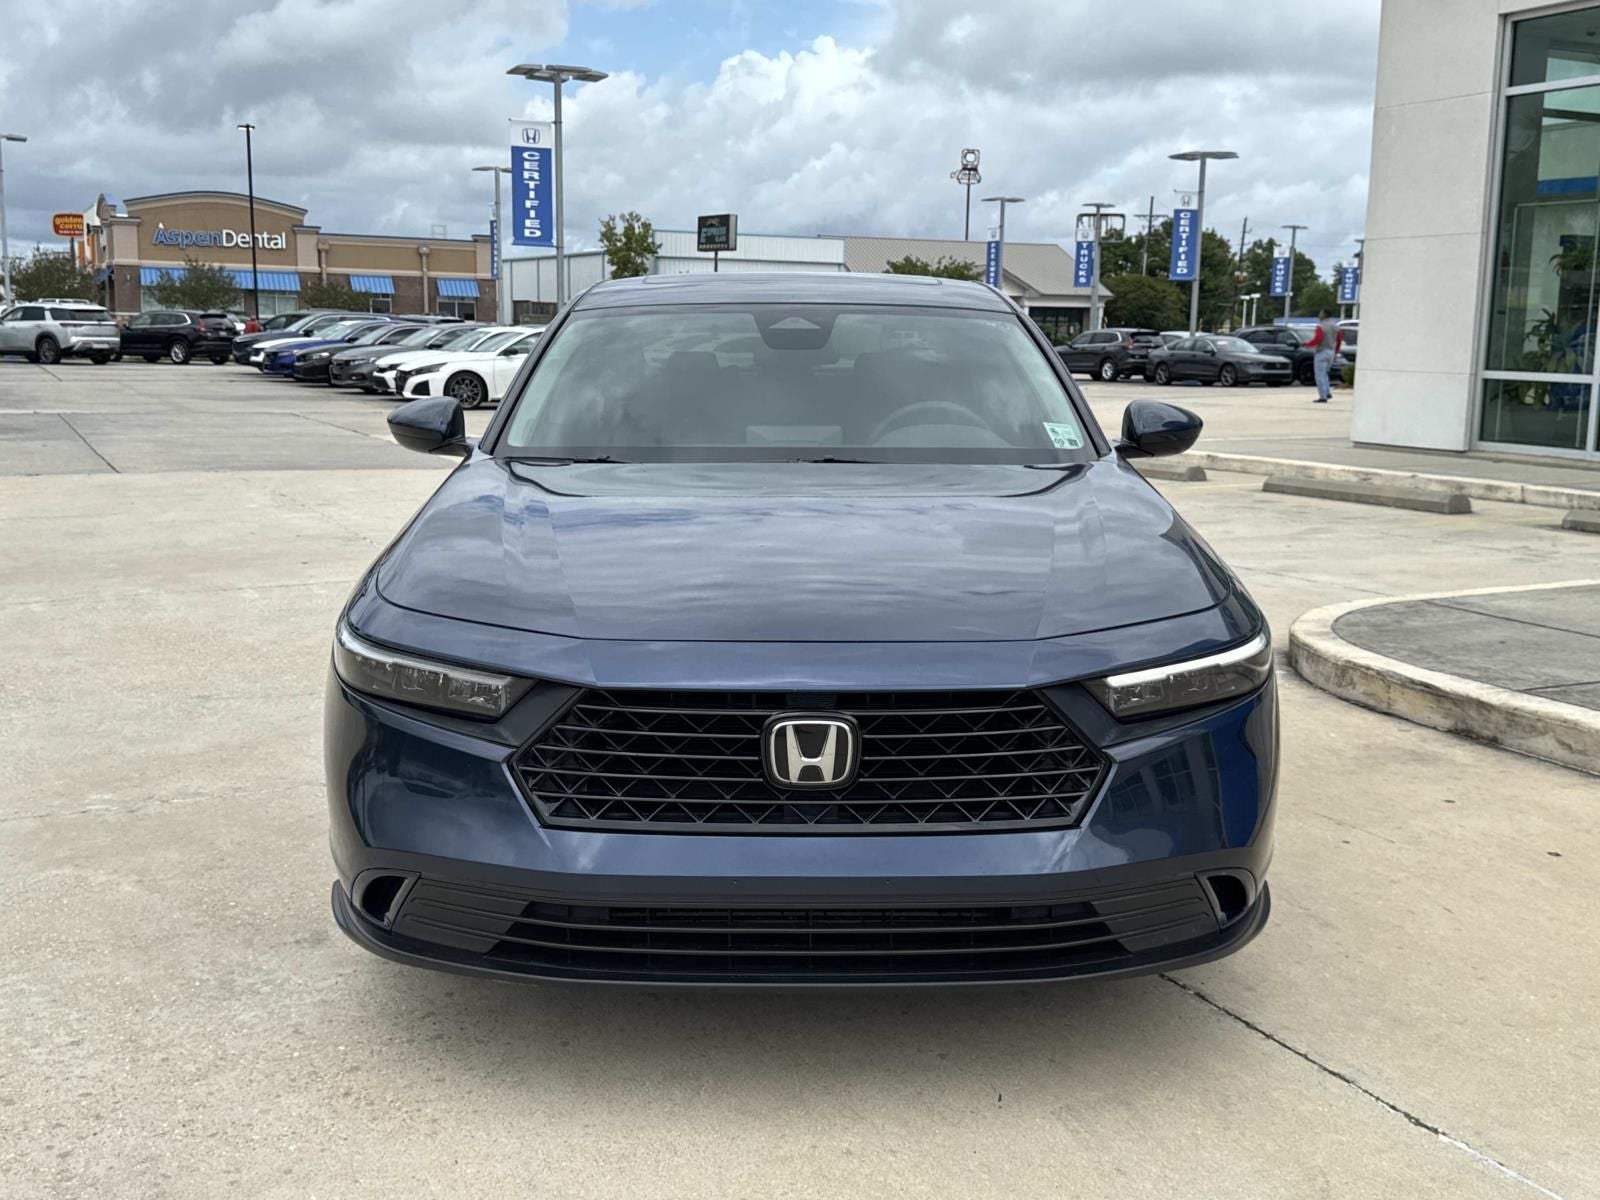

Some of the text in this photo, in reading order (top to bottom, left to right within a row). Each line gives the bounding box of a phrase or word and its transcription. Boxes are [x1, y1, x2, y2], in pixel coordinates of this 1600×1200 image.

[522, 151, 542, 238] CERTIFIED
[1078, 242, 1089, 283] TRUCKS
[1176, 211, 1191, 274] CERTIFIED
[1274, 259, 1285, 293] TRUCKS
